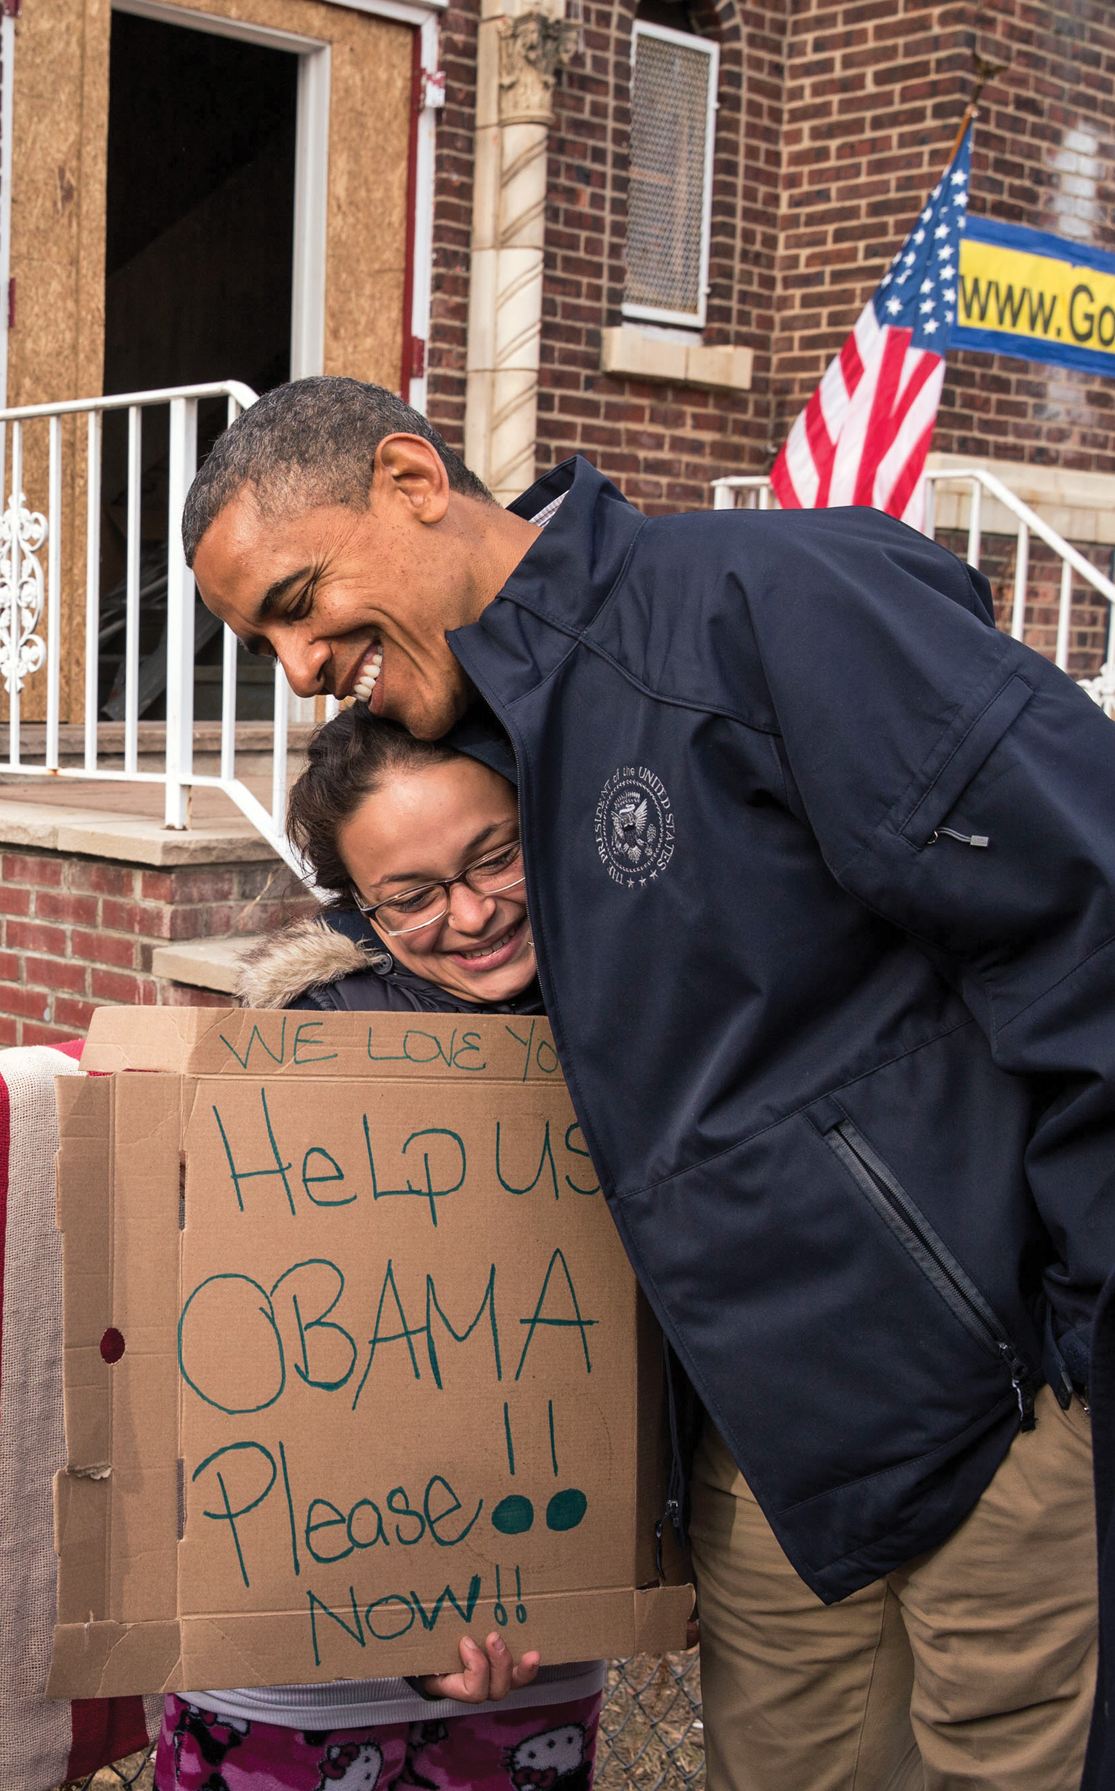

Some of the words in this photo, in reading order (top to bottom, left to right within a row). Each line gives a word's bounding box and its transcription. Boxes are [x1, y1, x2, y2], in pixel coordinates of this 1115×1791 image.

[594, 779, 612, 864] PRESIDENT
[613, 768, 621, 783] of
[623, 766, 636, 777] the
[638, 766, 671, 809] UNITED
[656, 813, 676, 871] STATES
[219, 1016, 338, 1069] WE
[368, 1028, 486, 1072] LOVE
[505, 1018, 560, 1083] YO
[178, 1249, 600, 1416] OBAMA
[307, 1565, 528, 1667] NOW!!
